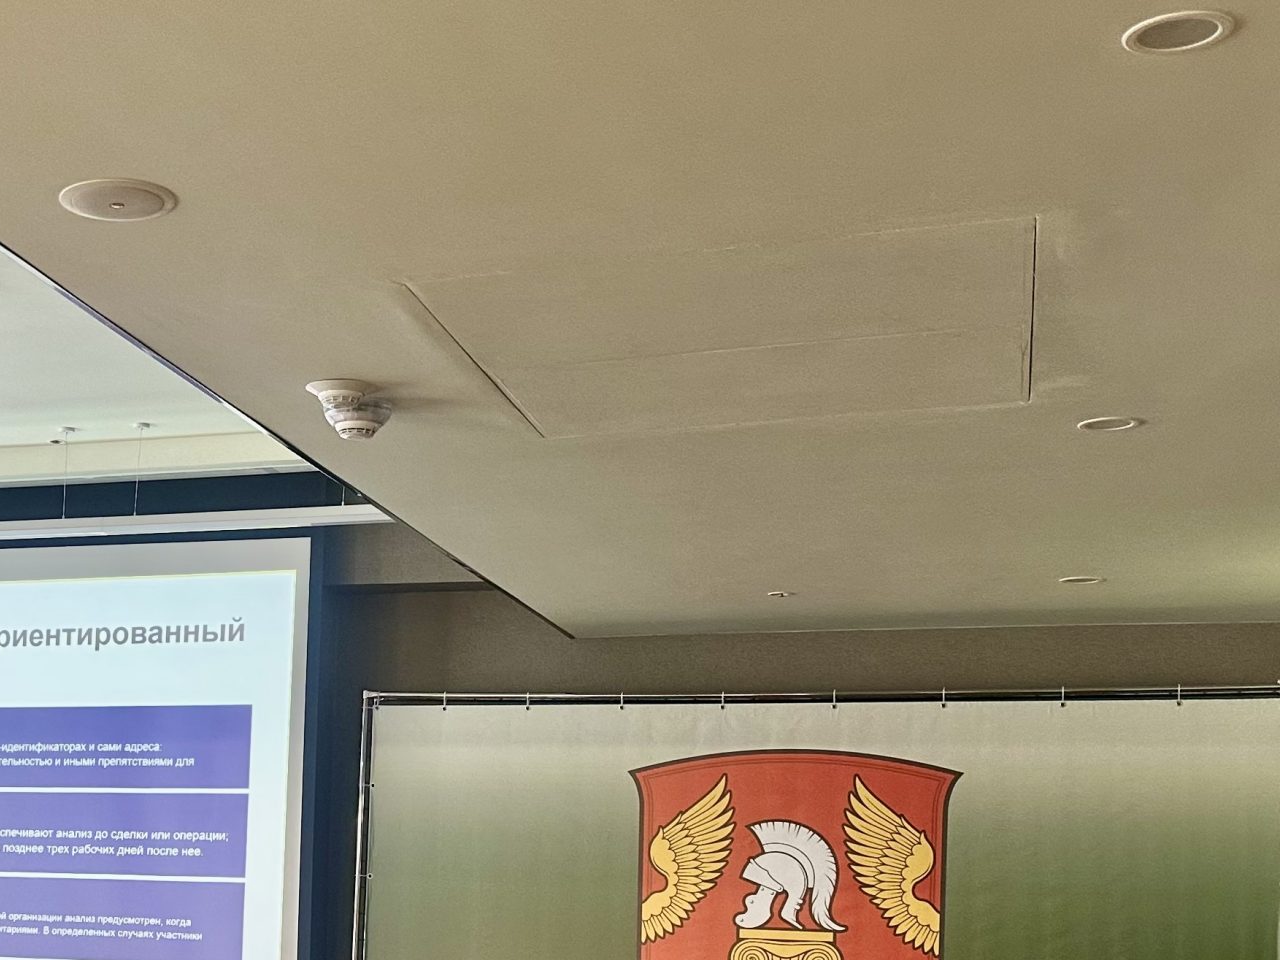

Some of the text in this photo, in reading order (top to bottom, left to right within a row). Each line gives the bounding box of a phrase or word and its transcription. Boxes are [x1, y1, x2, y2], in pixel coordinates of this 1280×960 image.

[88, 743, 95, 751] и
[96, 743, 122, 751] сами
[54, 757, 61, 766] и
[62, 757, 95, 766] иными
[97, 757, 173, 768] препятствиями
[174, 757, 194, 767] для
[55, 829, 92, 838] анализ
[93, 830, 108, 840] до
[110, 830, 148, 841] сделки
[150, 831, 170, 840] или
[172, 831, 228, 843] операции;
[1, 844, 44, 854] позднее
[46, 845, 69, 856] трех
[70, 843, 114, 857] рабочих
[115, 844, 144, 856] дней
[146, 846, 178, 856] после
[7, 912, 62, 925] организации
[63, 914, 96, 924] анализ
[165, 918, 191, 928] когда
[42, 924, 49, 935] В
[51, 927, 115, 940] определенных
[117, 929, 154, 941] случаях
[155, 930, 202, 943] участники
